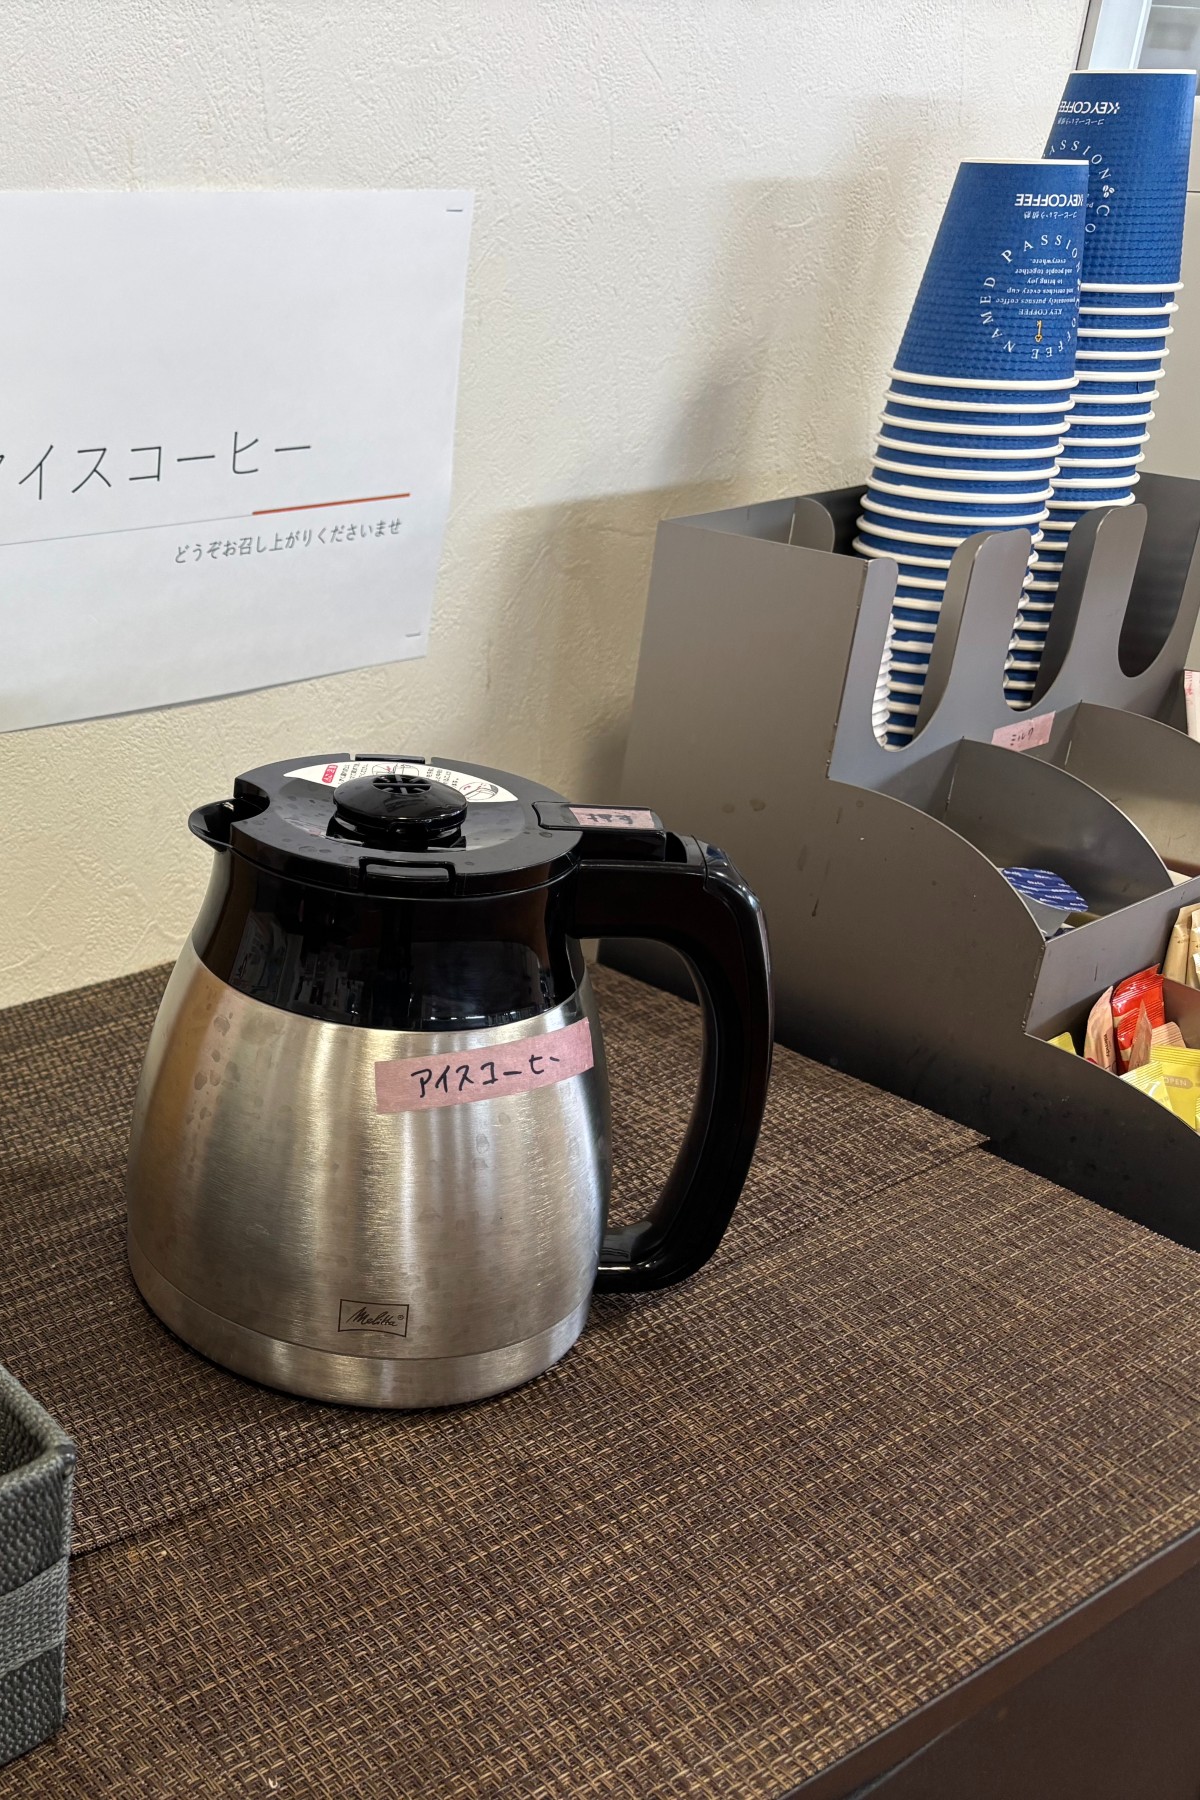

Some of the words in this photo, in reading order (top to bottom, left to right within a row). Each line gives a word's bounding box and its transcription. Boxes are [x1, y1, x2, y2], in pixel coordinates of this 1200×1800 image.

[1014, 193, 1084, 207] KEYCOFFEE
[1014, 267, 1044, 275] together
[1006, 288, 1020, 296] cup
[1017, 308, 1048, 316] COFFEE
[1049, 308, 1063, 316] KEY
[174, 518, 402, 564] どうぞお召し上がりくださいませ
[411, 1054, 560, 1098] アイスコーヒー
